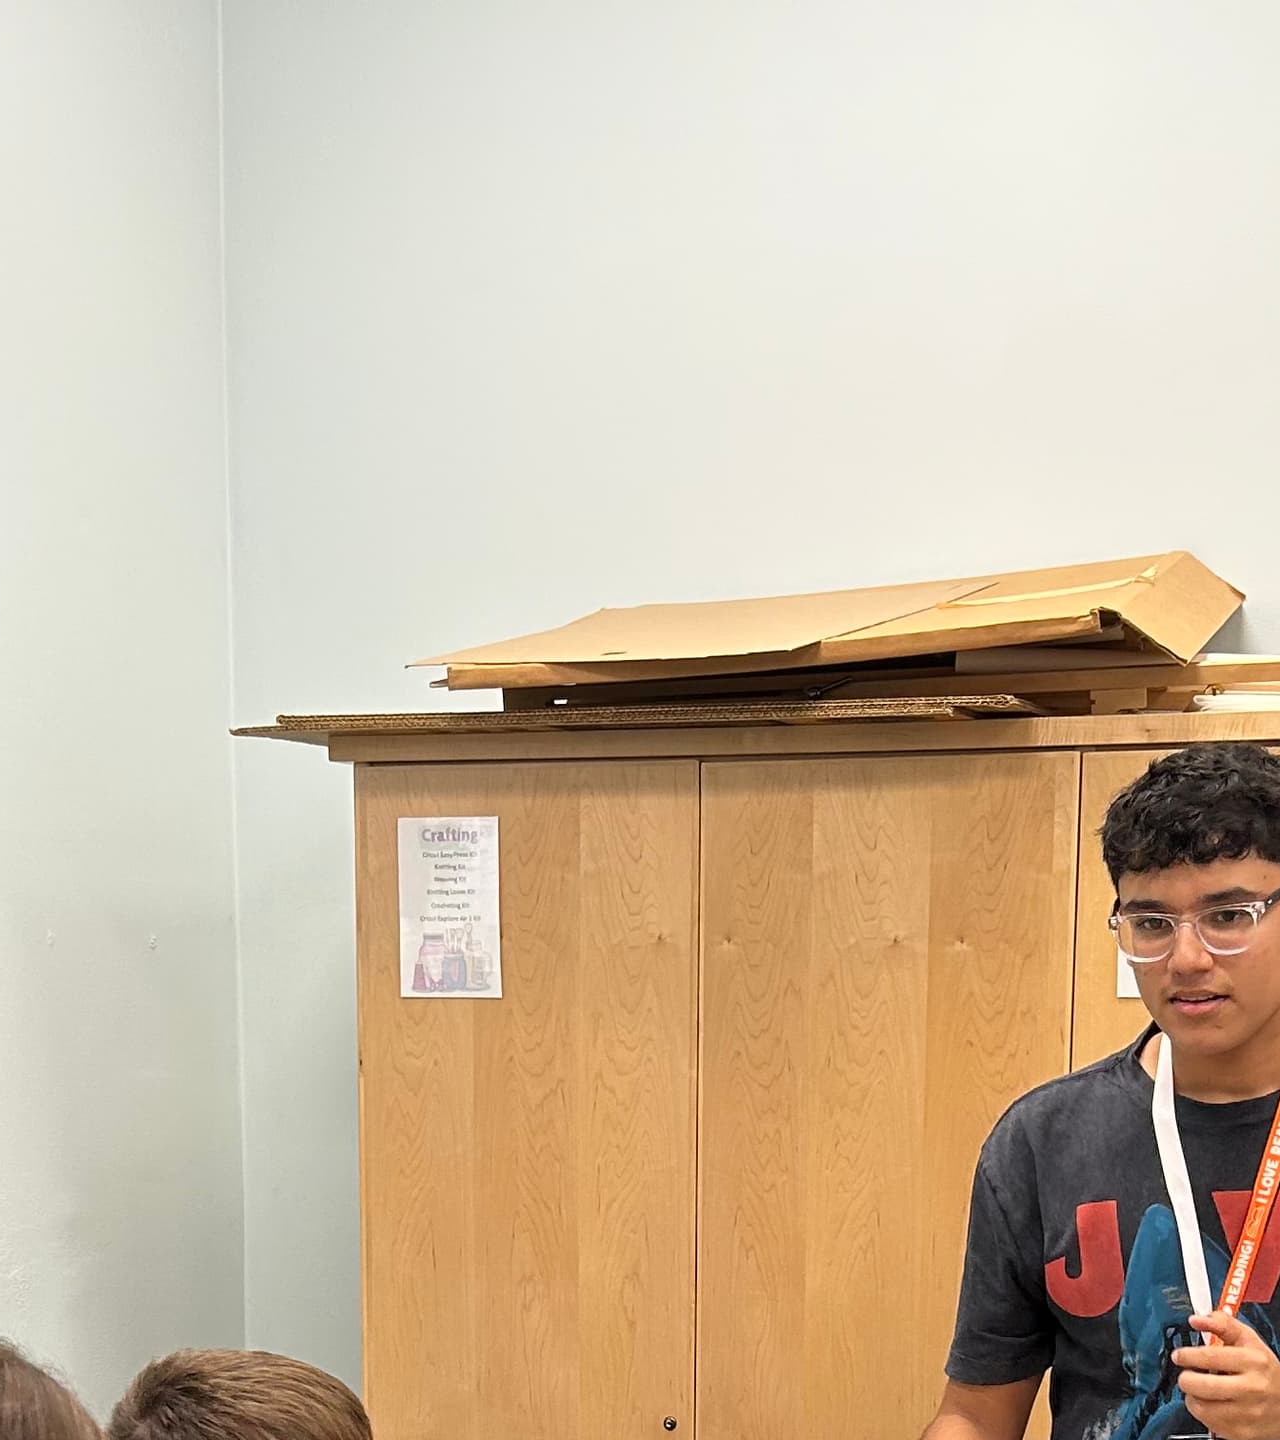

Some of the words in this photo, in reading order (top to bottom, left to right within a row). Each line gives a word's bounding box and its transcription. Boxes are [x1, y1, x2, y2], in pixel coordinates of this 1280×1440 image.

[422, 827, 478, 844] Crafting
[1261, 1159, 1279, 1196] LOVE
[1228, 1241, 1255, 1306] READING!
